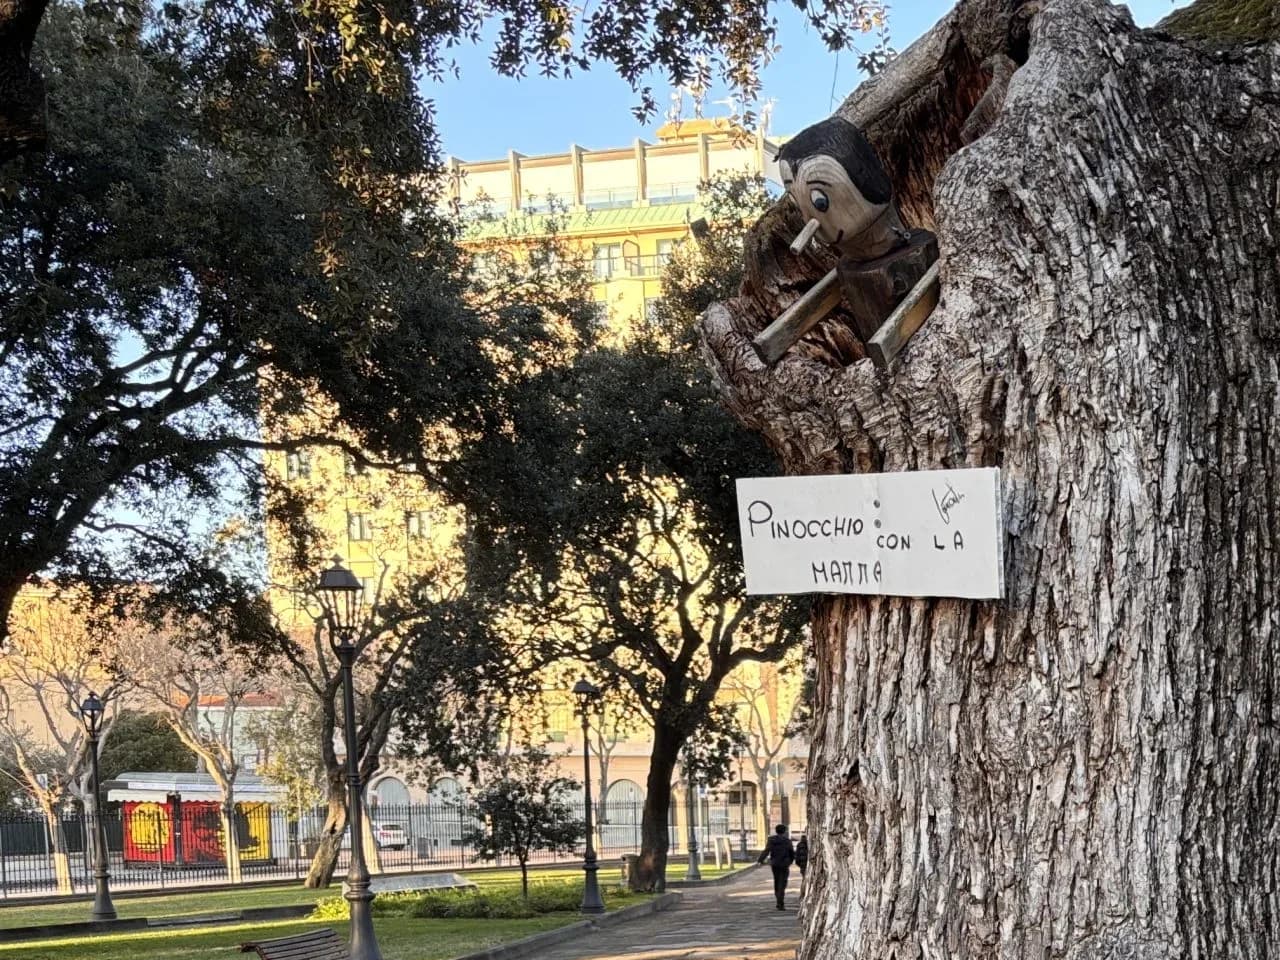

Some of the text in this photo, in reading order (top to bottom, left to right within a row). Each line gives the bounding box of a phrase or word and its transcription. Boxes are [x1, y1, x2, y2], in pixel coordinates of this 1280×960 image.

[747, 500, 964, 550] PINOCCHIO CON LA
